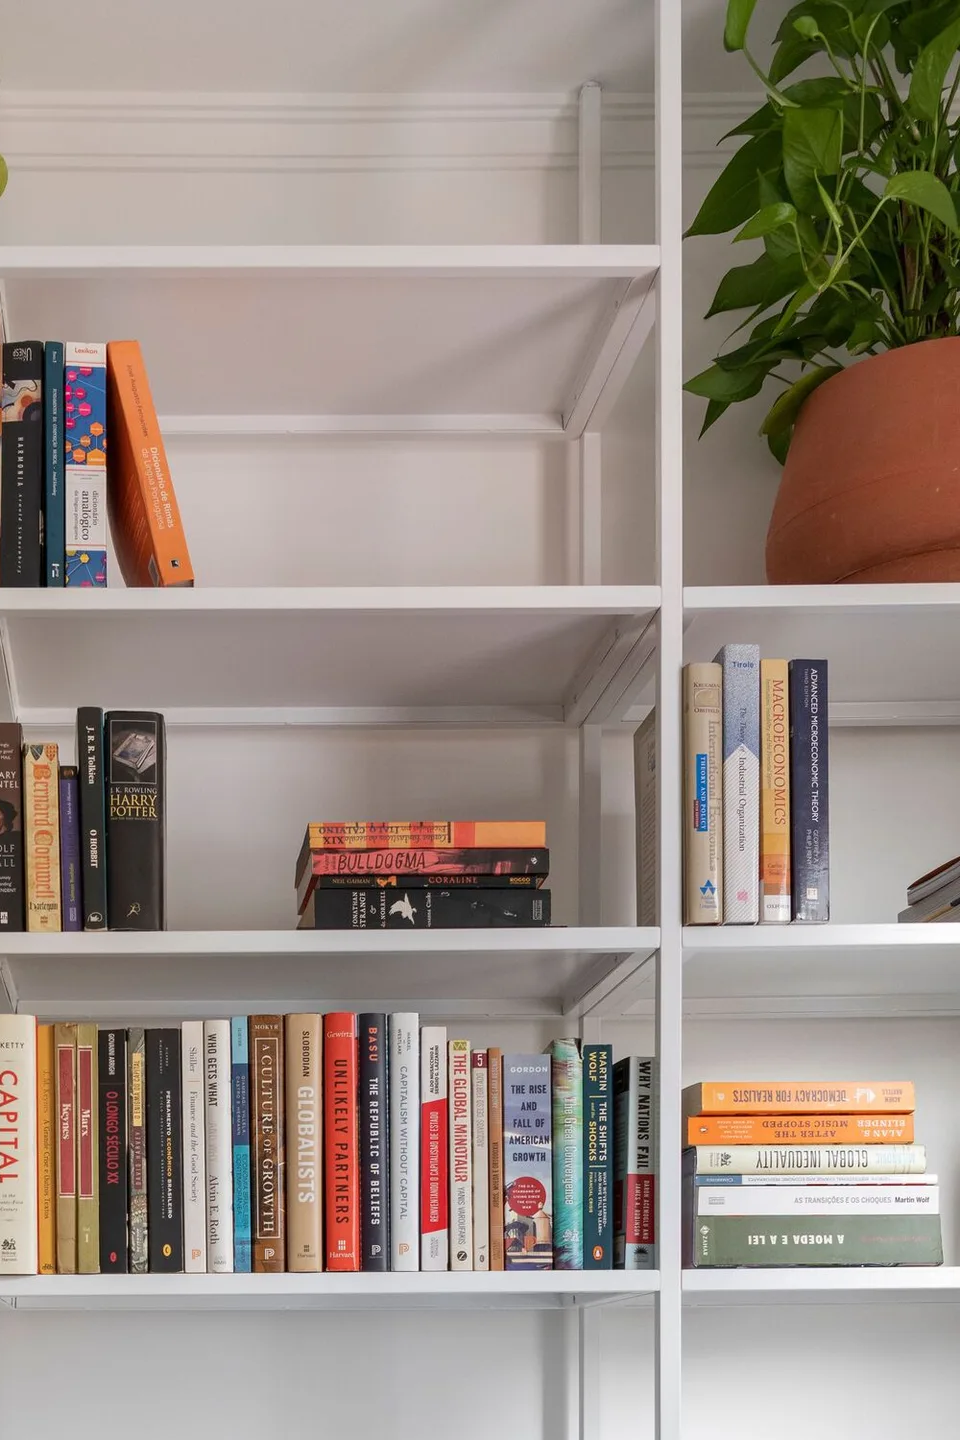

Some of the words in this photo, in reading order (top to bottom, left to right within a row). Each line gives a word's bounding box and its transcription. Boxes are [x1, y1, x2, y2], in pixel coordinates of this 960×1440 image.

[150, 447, 166, 489] Dicionário
[160, 491, 168, 501] de
[80, 490, 92, 541] analógico
[162, 504, 174, 528] Rimas
[810, 668, 818, 713] ADVANCED
[87, 735, 94, 743] R.
[87, 745, 94, 754] R.
[772, 680, 786, 825] MACROECONOMICS
[810, 716, 819, 788] MICROECONOMIC
[88, 756, 96, 784] Tolkien
[110, 794, 157, 806] HARRY
[110, 806, 157, 818] POTTER
[90, 838, 98, 868] HOBBIT
[337, 852, 426, 872] BULLDOGMA
[428, 876, 478, 884] CORALINE
[208, 1034, 217, 1054] WHO
[302, 1031, 310, 1078] SLOBODIAN
[368, 1027, 378, 1061] BASU
[189, 1046, 197, 1072] Shiller
[208, 1057, 217, 1080] GETS
[454, 1054, 467, 1075] THE
[477, 1054, 483, 1066] 5
[588, 1051, 596, 1082] WOLF
[599, 1051, 607, 1091] MARTIN
[638, 1060, 651, 1089] WHY
[208, 1082, 217, 1107] WHAT
[261, 1054, 273, 1135] CULTURE
[334, 1059, 348, 1134] UNLIKELY
[369, 1077, 378, 1095] THE
[511, 1085, 525, 1094] THE
[529, 1085, 547, 1094] RISE
[733, 1090, 774, 1102] REALISTS
[775, 1090, 791, 1102] FOR
[795, 1089, 847, 1102] DEMOCRACY
[190, 1091, 198, 1121] Finance
[454, 1078, 467, 1121] GLOBAL
[520, 1102, 537, 1111] AND
[60, 1103, 72, 1140] Keynes
[81, 1108, 90, 1137] Marx
[106, 1101, 118, 1133] LONGO
[599, 1102, 607, 1122] THE
[638, 1094, 650, 1140] NATIONS
[190, 1123, 198, 1135] and
[369, 1101, 379, 1156] REPUBLIC
[513, 1118, 532, 1128] FALL
[535, 1118, 544, 1128] OF
[762, 1120, 811, 1128] STOPPED
[814, 1120, 848, 1128] MUSIC
[297, 1086, 315, 1203] GLOBALISTS
[509, 1135, 550, 1145] AMERICAN
[599, 1125, 607, 1161] SHIFTS
[774, 1130, 796, 1138] THE
[800, 1130, 836, 1138] AFTER
[106, 1136, 121, 1169] SÉCULO
[190, 1138, 198, 1152] the
[264, 1139, 272, 1154] OF
[400, 1128, 408, 1175] WITHOUT
[454, 1124, 468, 1183] MINOTAUR
[190, 1153, 198, 1173] Good
[512, 1152, 546, 1162] GROWTH
[636, 1146, 649, 1169] FAIL
[755, 1150, 821, 1168] INEQUALITY
[825, 1150, 869, 1168] GLOBAL
[107, 1171, 119, 1184] XX
[370, 1163, 380, 1175] OF
[190, 1175, 198, 1202] Society
[209, 1174, 218, 1202] Alvin
[335, 1142, 350, 1224] PARTNERS
[262, 1158, 274, 1232] GROWTH
[370, 1180, 380, 1225] BELIEFS
[400, 1178, 408, 1220] CAPITAL
[895, 1196, 915, 1204] Martin
[916, 1196, 929, 1204] Wolf
[209, 1205, 218, 1216] E.
[209, 1219, 219, 1245] Roth
[748, 1235, 766, 1245] LEI
[770, 1235, 778, 1245] A
[782, 1235, 788, 1244] E
[792, 1234, 833, 1244] MOEDA
[837, 1234, 844, 1244] A
